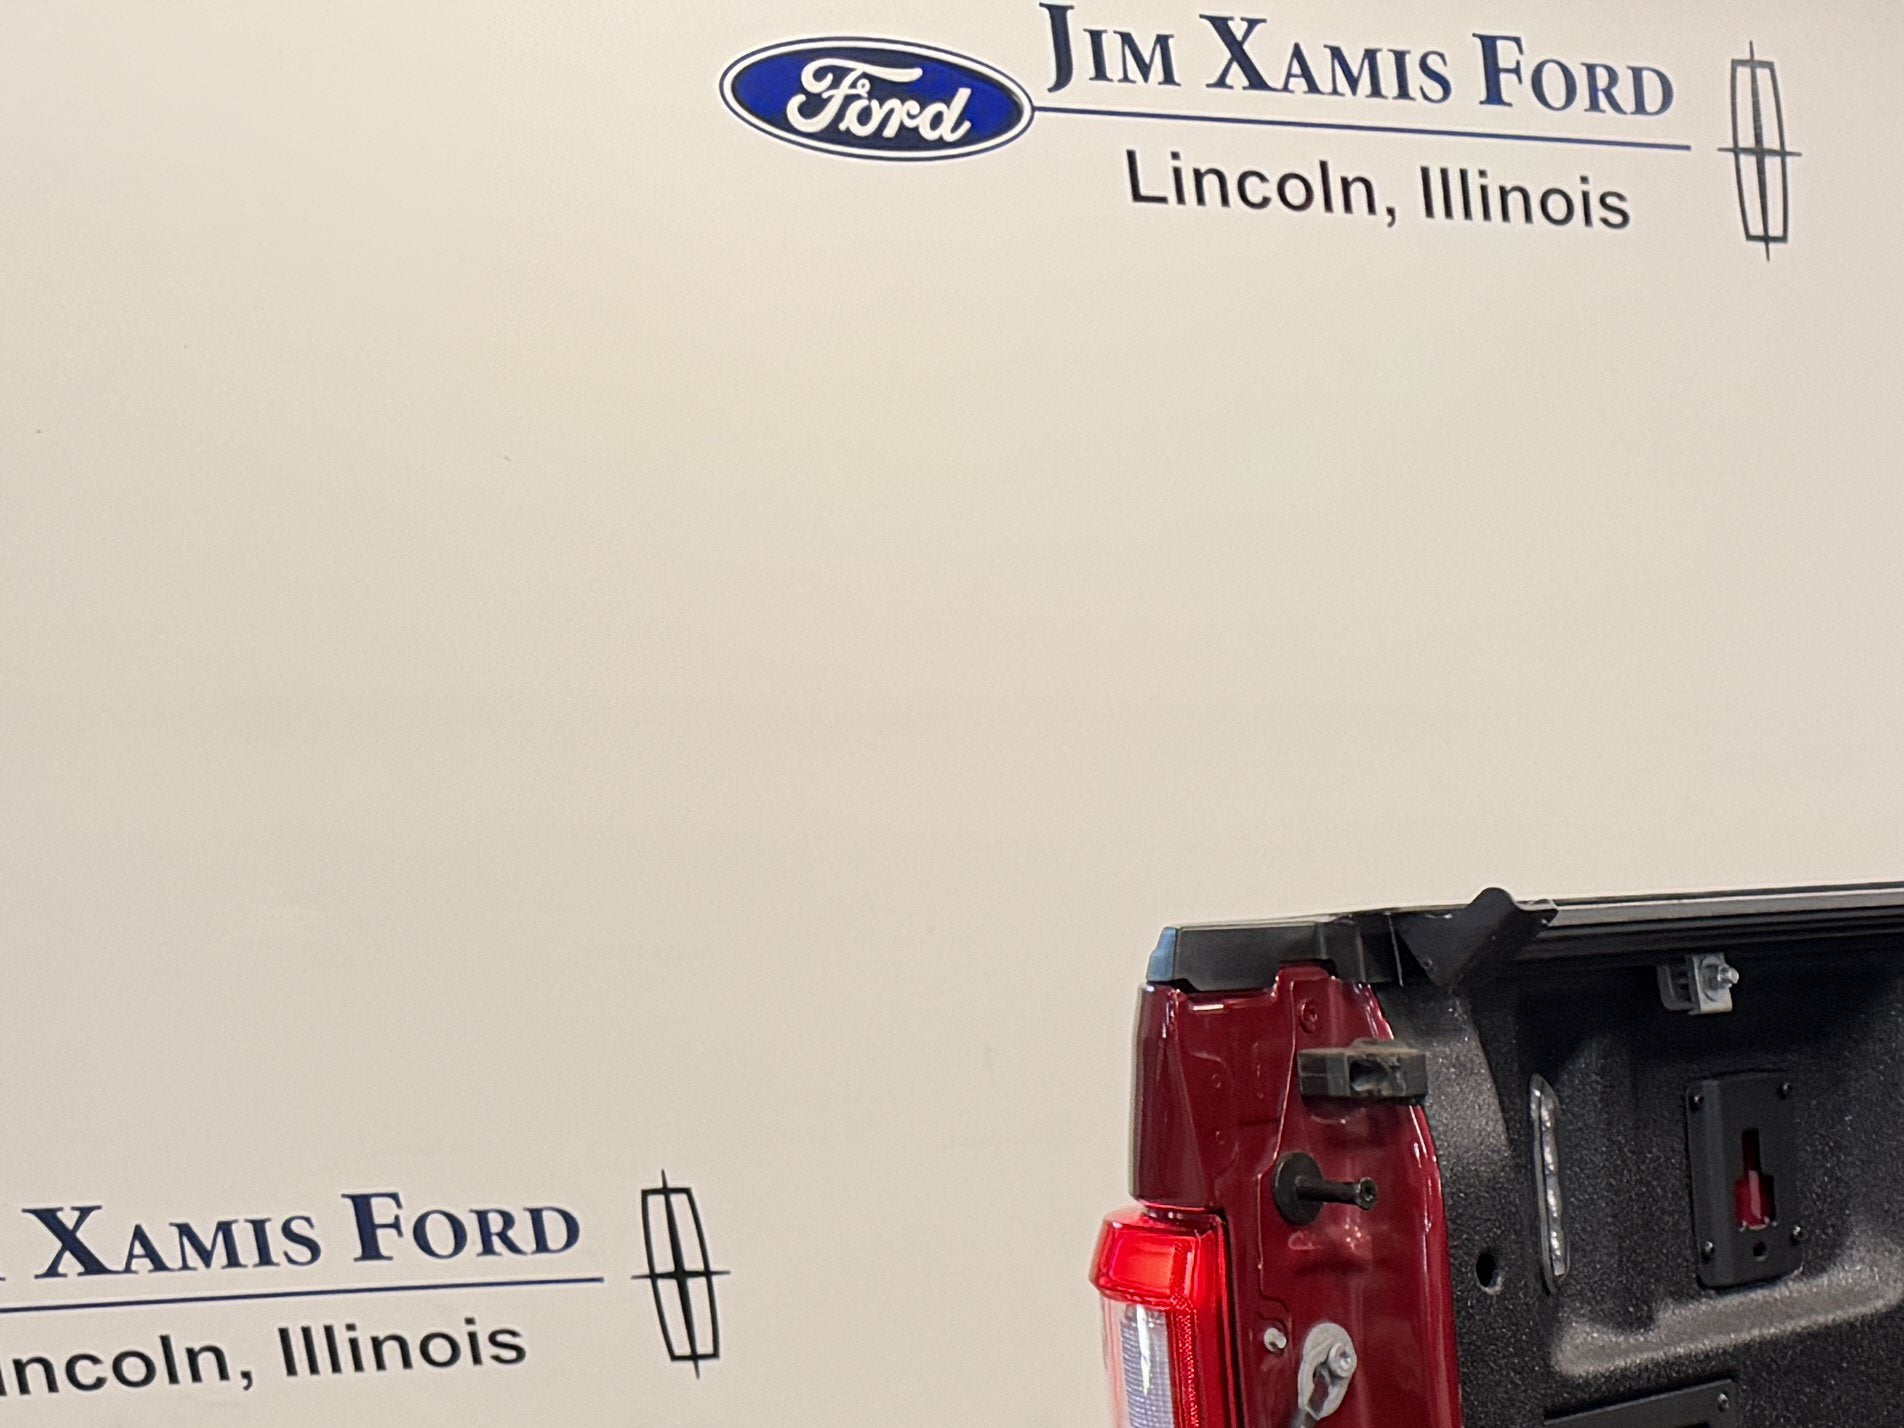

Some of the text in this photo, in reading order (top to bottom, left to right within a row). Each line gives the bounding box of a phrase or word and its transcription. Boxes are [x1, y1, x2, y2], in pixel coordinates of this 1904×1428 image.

[786, 57, 972, 143] Ford
[1038, 2, 1675, 116] JIM XAMIS FORD
[1125, 149, 1631, 230] Lincoln, Illinois
[21, 1192, 581, 1280] XAMIS FORD
[0, 1317, 526, 1397] ncoln, Illinois
